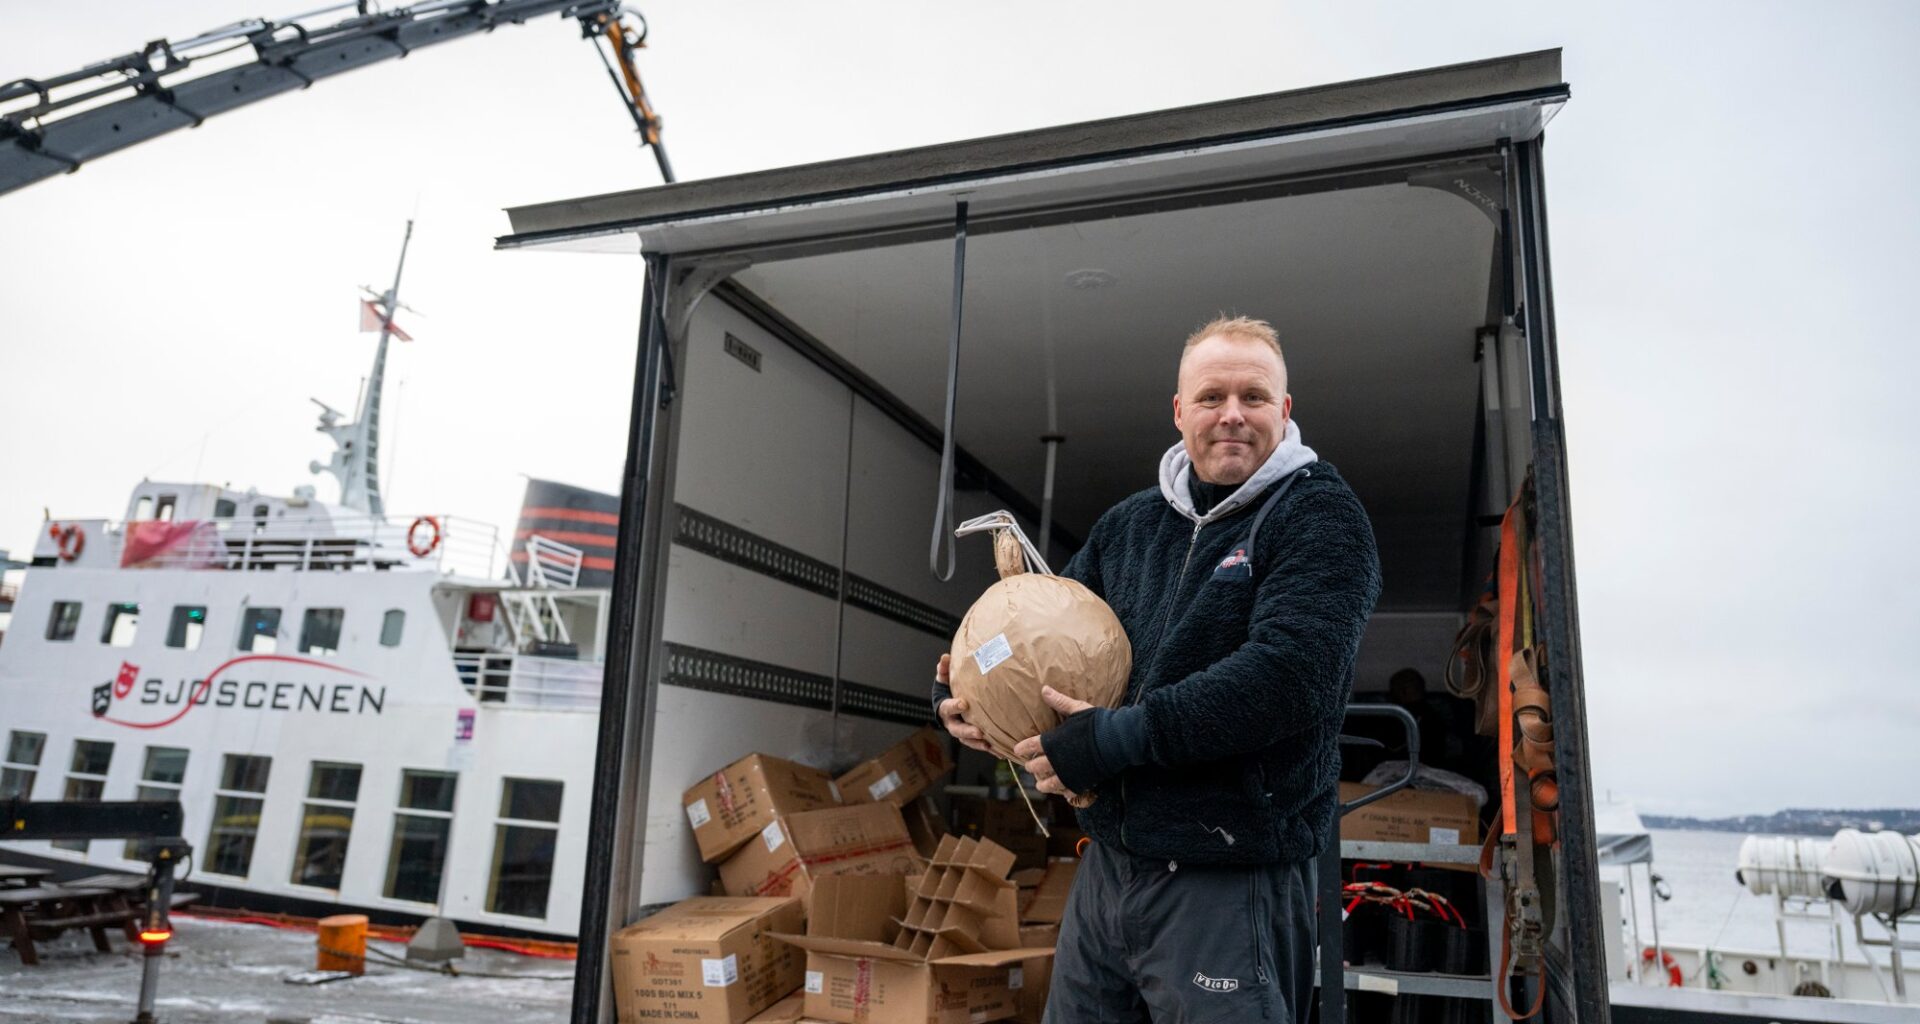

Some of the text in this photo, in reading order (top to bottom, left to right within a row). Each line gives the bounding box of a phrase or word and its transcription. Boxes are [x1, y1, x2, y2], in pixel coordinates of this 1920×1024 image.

[658, 989, 676, 998] BIG
[678, 990, 696, 999] MIX
[640, 1009, 699, 1019] MADE IN CHINA
